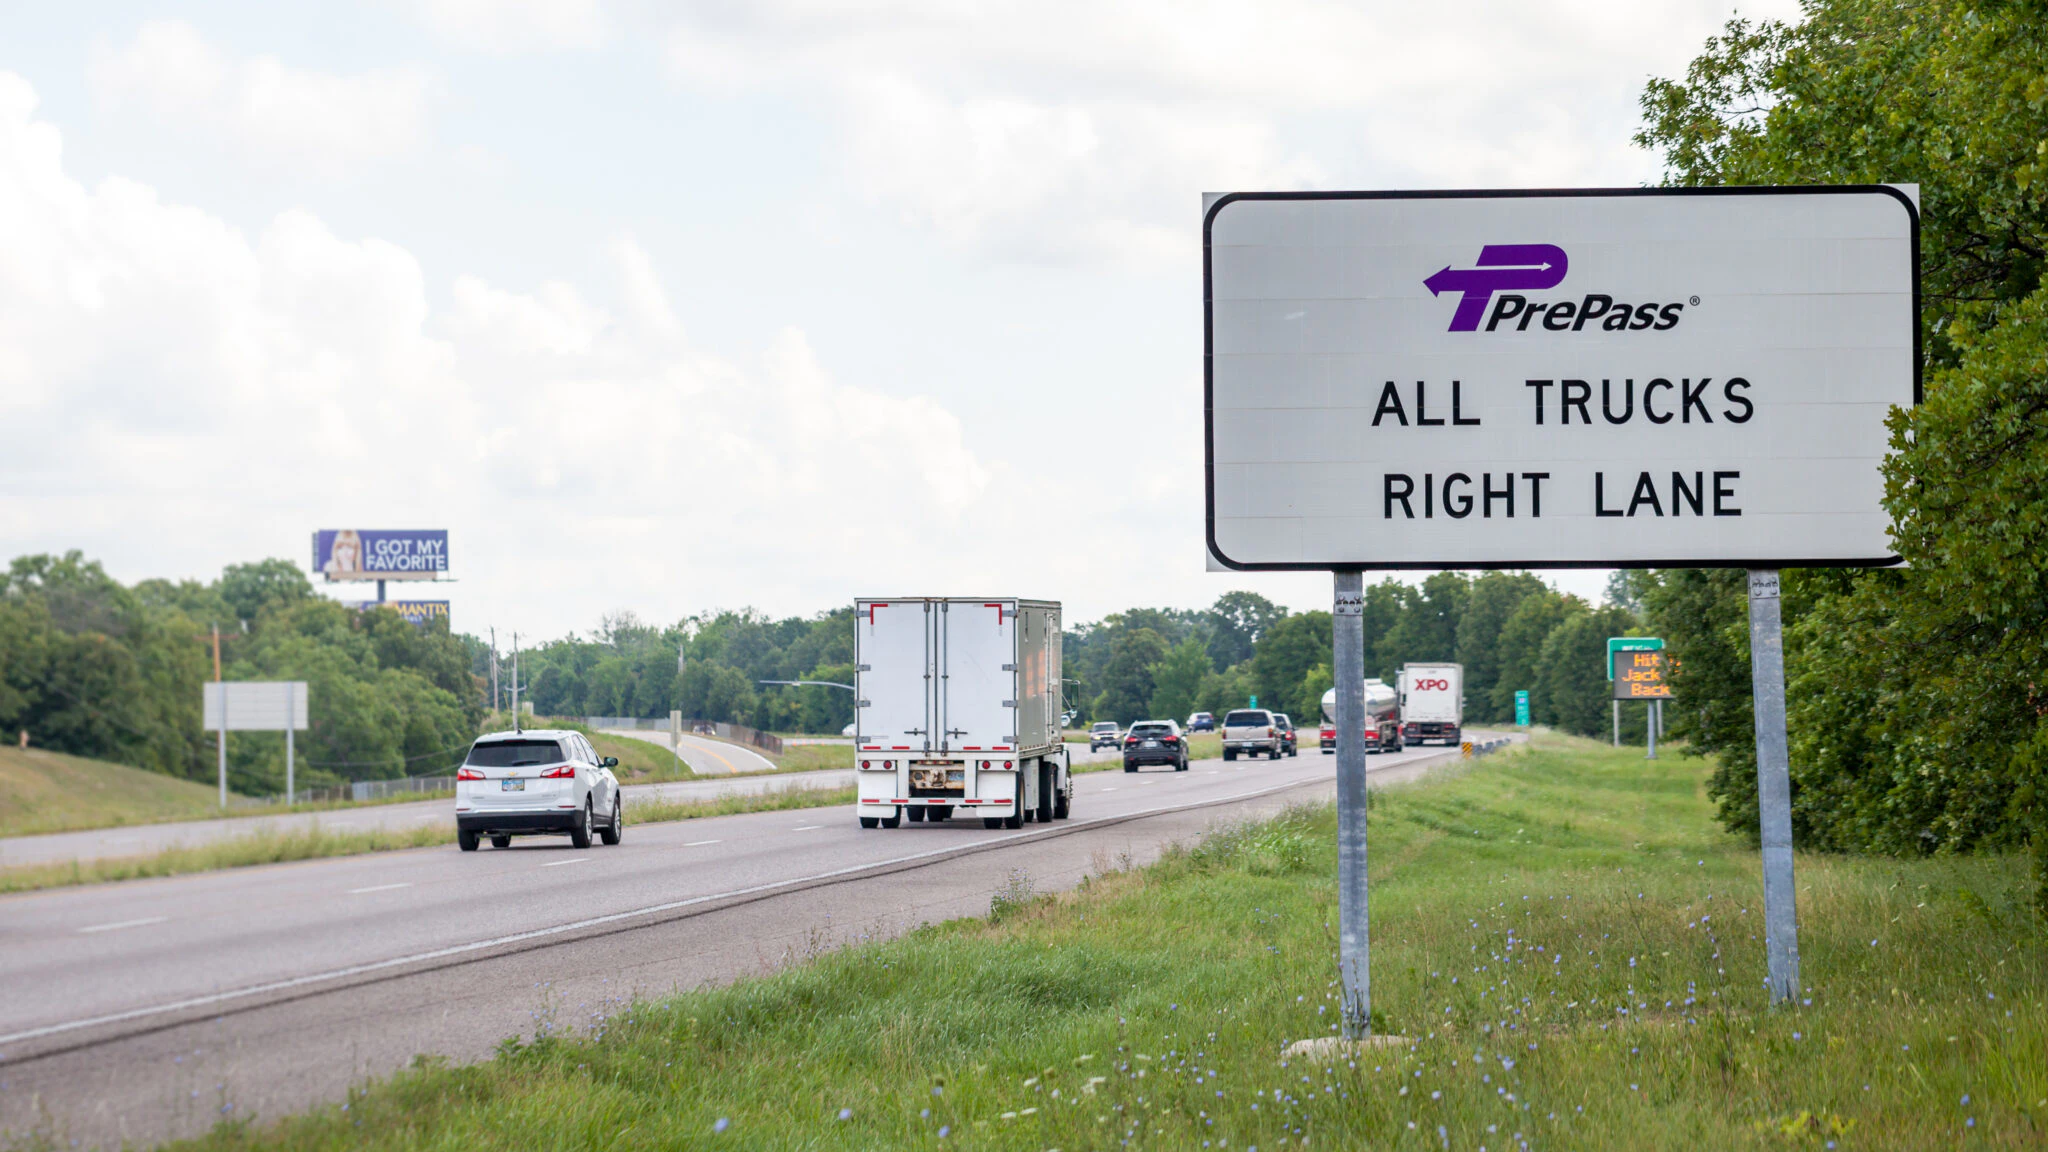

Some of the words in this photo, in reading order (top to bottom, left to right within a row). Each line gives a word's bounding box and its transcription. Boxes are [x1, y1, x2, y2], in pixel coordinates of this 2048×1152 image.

[1372, 380, 1481, 427] ALL
[1525, 377, 1754, 425] TRUCKS
[1384, 472, 1550, 519] RIGHT
[1595, 471, 1742, 518] LANE
[375, 539, 412, 555] GOT
[417, 539, 444, 555] MY
[366, 555, 445, 570] FAVORITE
[1633, 653, 1660, 667] Hit
[1621, 668, 1662, 682] Jack
[1415, 679, 1449, 691] XPO
[1630, 683, 1671, 696] Back
